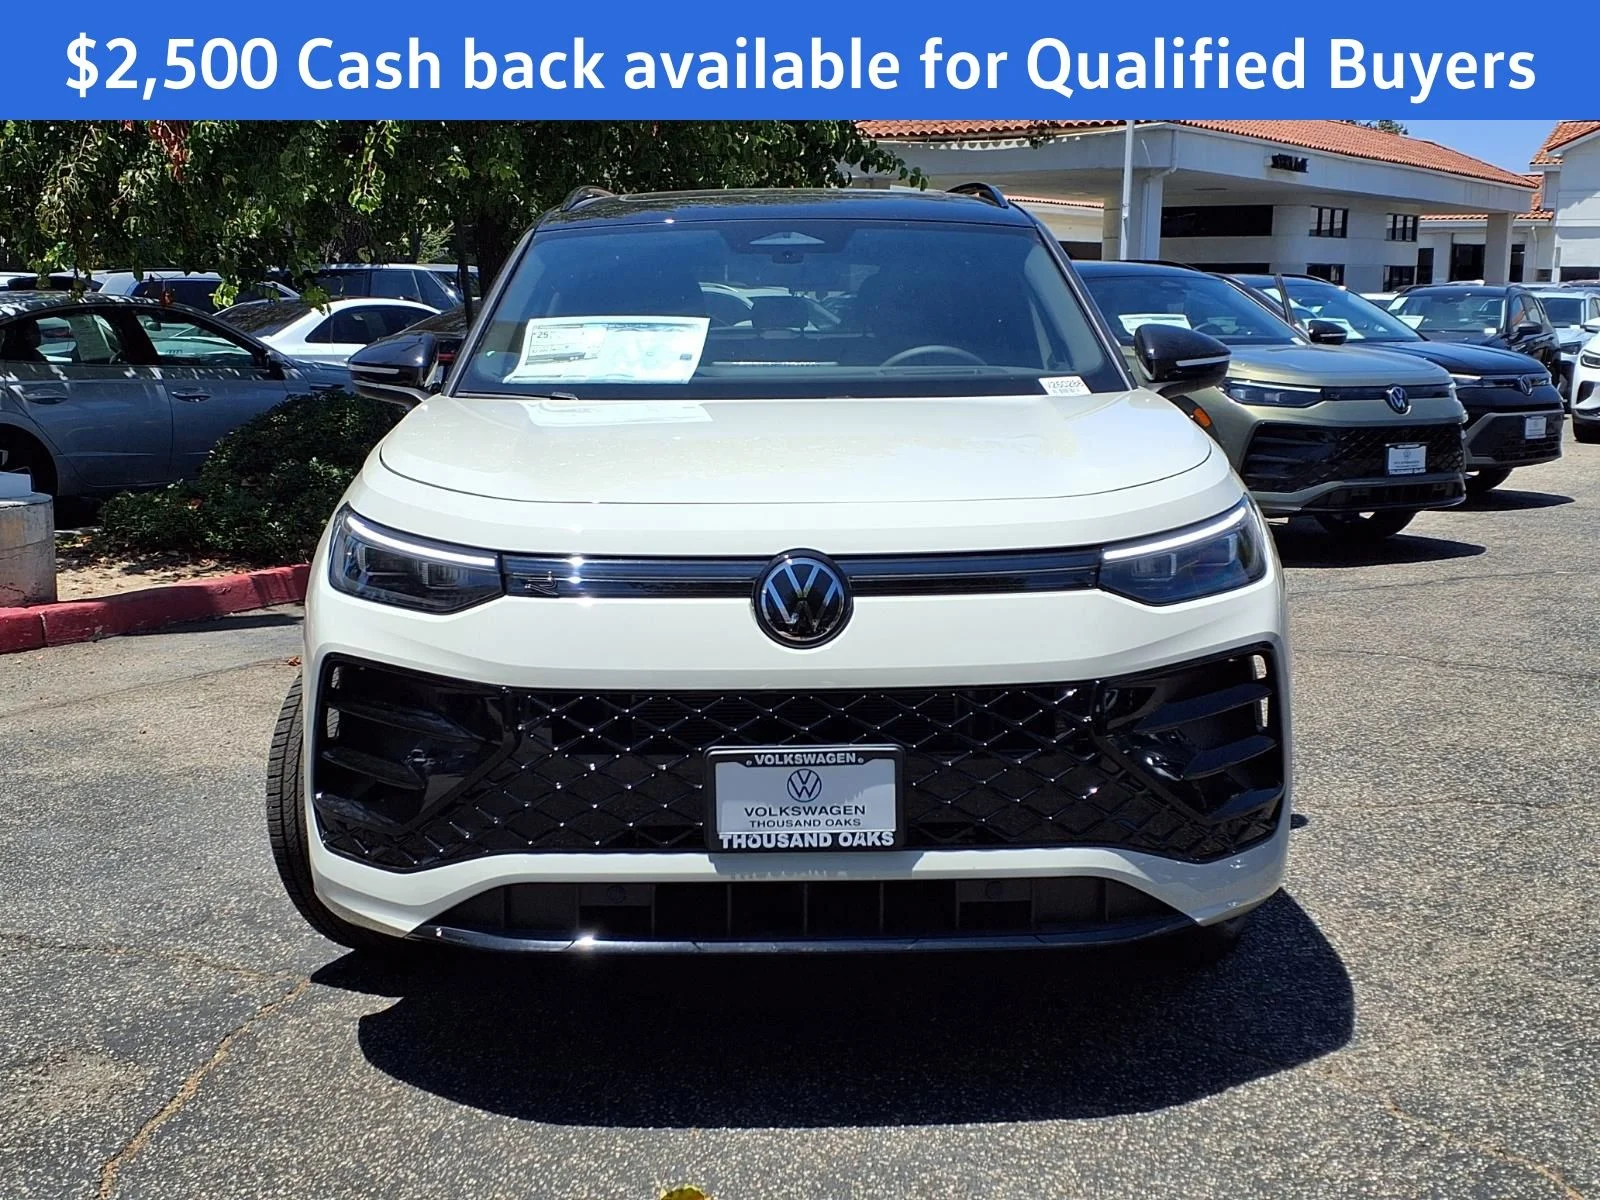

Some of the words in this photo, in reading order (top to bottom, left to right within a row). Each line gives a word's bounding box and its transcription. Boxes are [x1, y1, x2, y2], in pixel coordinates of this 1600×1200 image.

[754, 752, 857, 766] VOLKSWAGEN
[744, 804, 866, 817] VOLKSWAGEN
[750, 819, 821, 829] THOUSAND
[825, 818, 861, 828] OAKS
[719, 832, 833, 849] THOUSAND
[838, 831, 894, 848] OAKS
